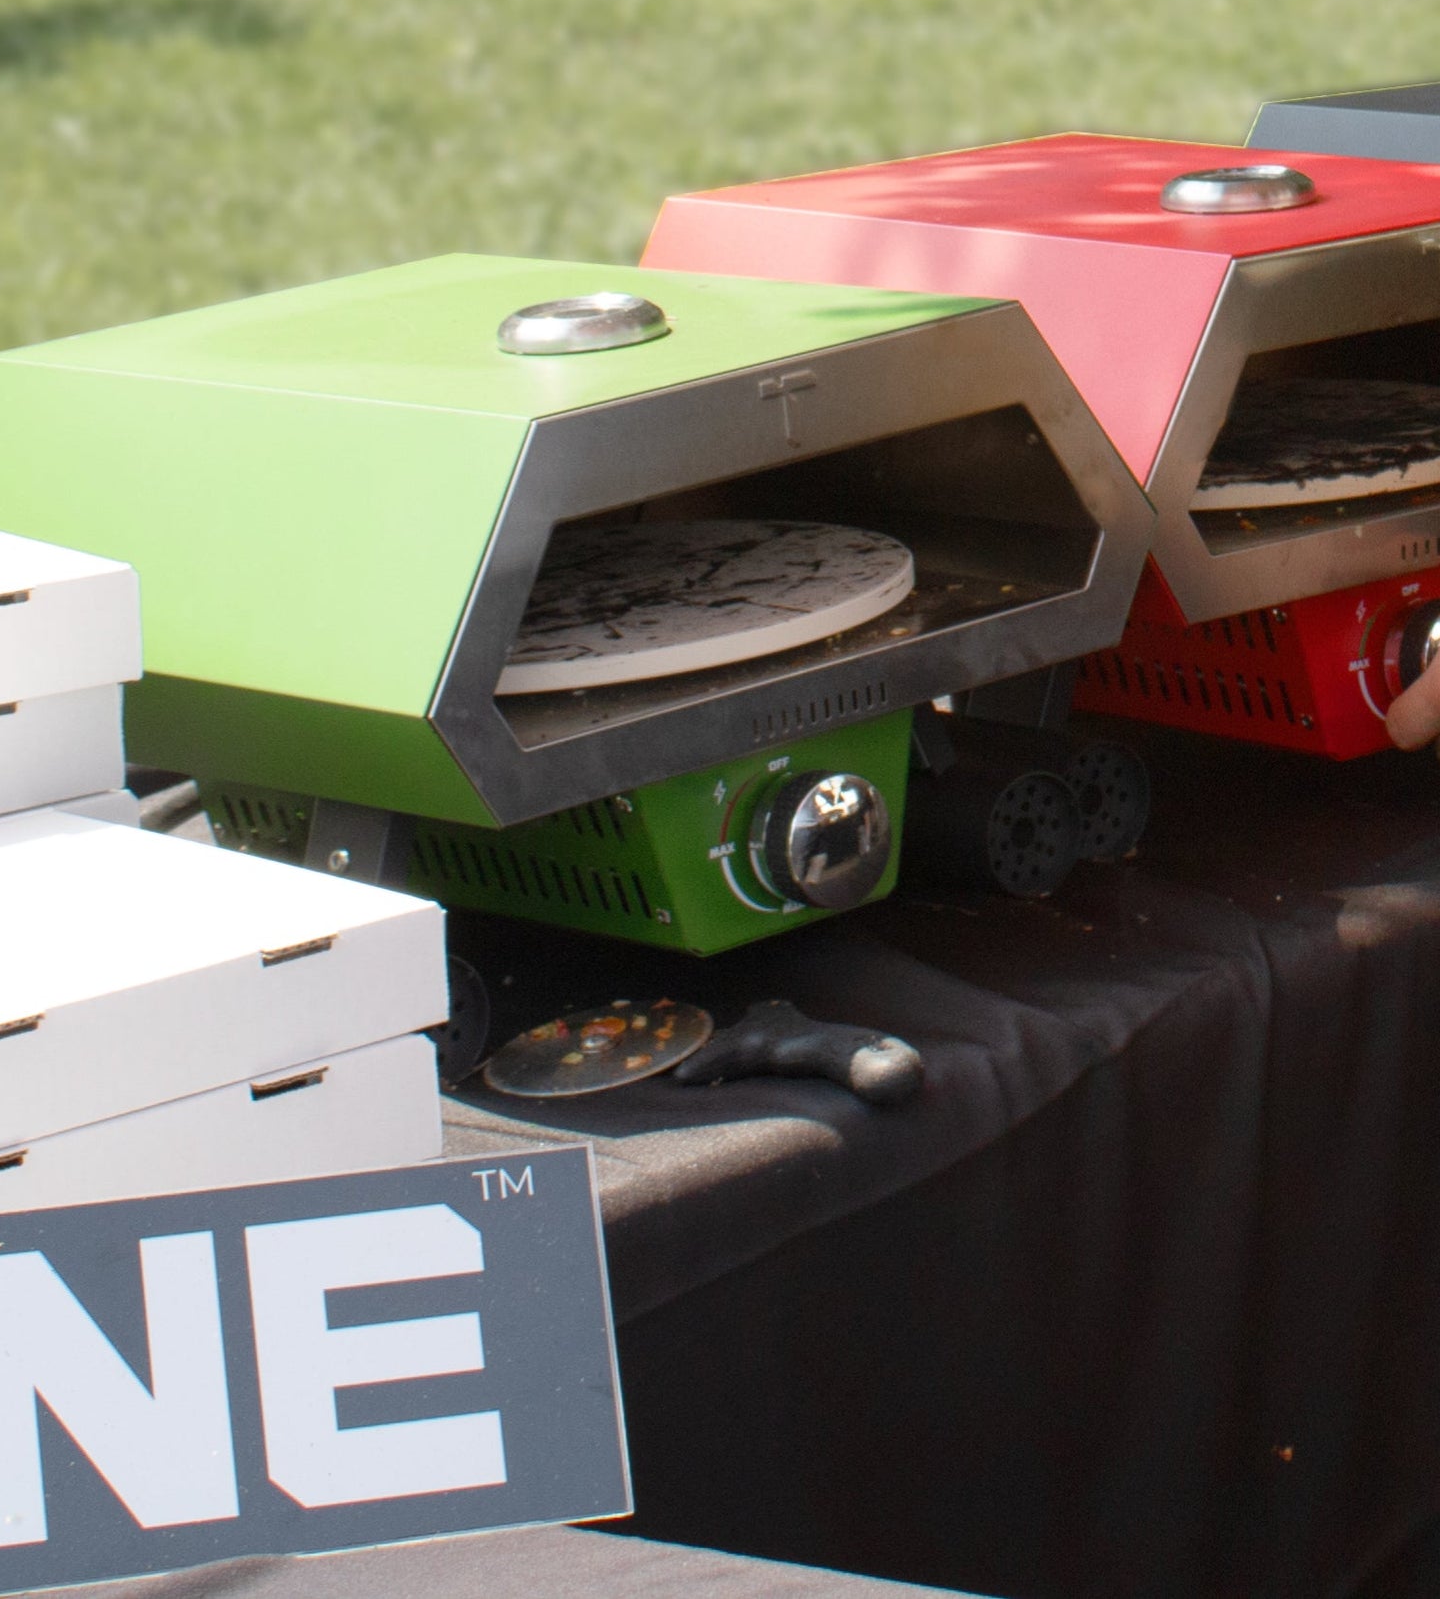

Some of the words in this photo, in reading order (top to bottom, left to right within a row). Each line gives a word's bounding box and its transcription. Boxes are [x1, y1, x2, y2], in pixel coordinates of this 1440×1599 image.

[767, 755, 791, 772] OFF
[708, 841, 737, 860] MAX
[471, 1165, 536, 1201] TM
